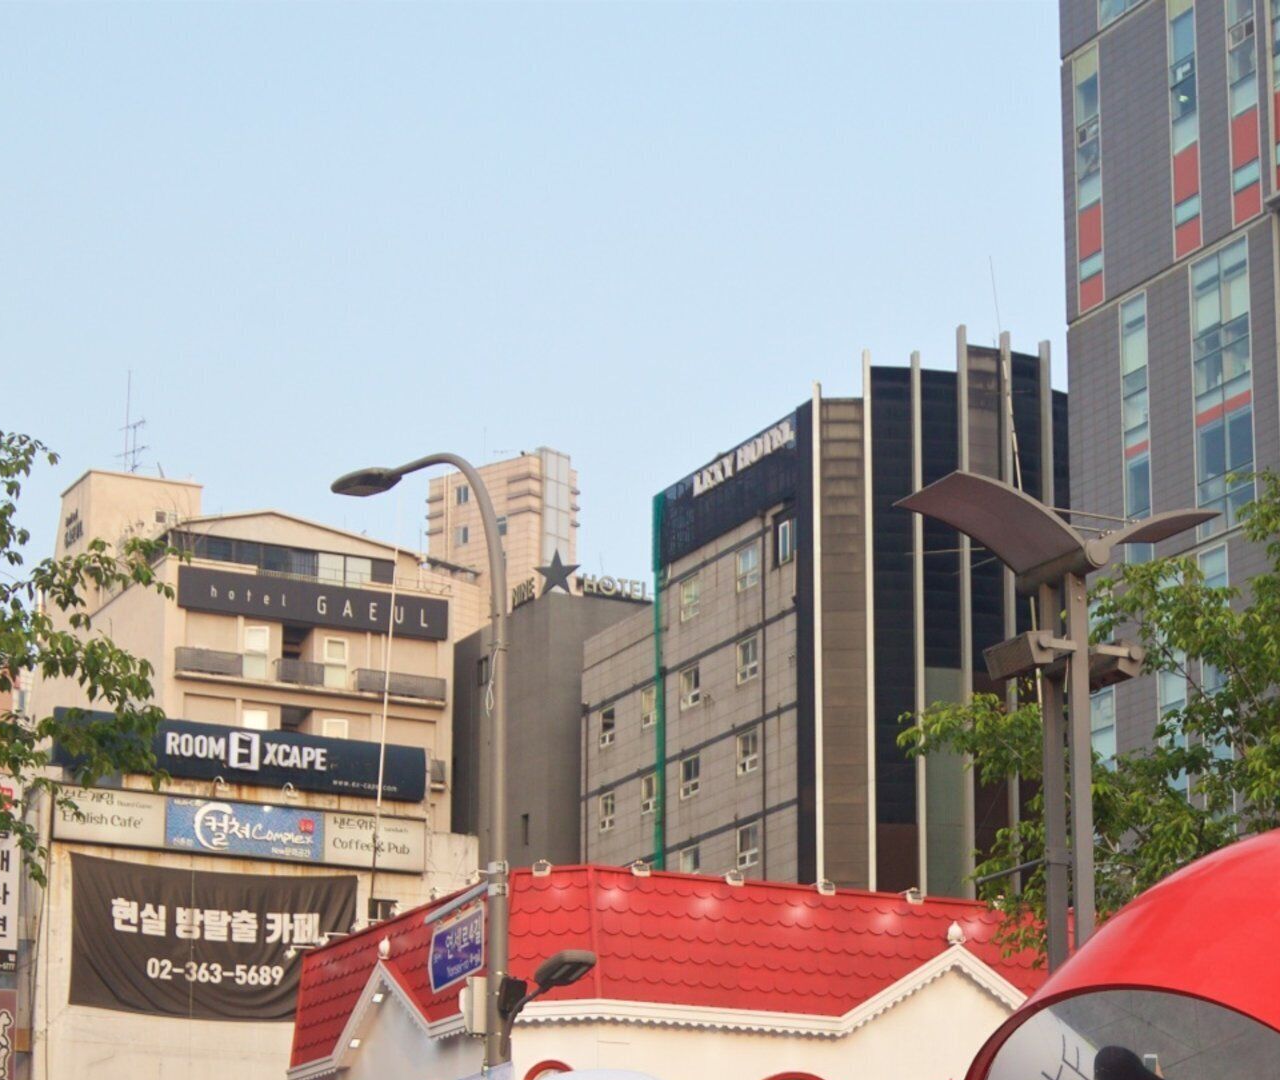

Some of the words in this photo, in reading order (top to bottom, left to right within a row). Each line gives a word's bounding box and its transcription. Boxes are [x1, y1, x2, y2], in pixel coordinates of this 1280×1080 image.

[736, 419, 795, 472] HOTEL
[583, 573, 653, 601] HOTEL
[210, 585, 287, 607] hotel
[317, 595, 429, 628] GAEUL
[166, 732, 226, 761] ROOM
[387, 842, 410, 855] Pub
[111, 898, 167, 937] 현실
[175, 906, 258, 944] 방탈출
[265, 912, 321, 945] 카페
[146, 957, 285, 987] 02-363-5689
